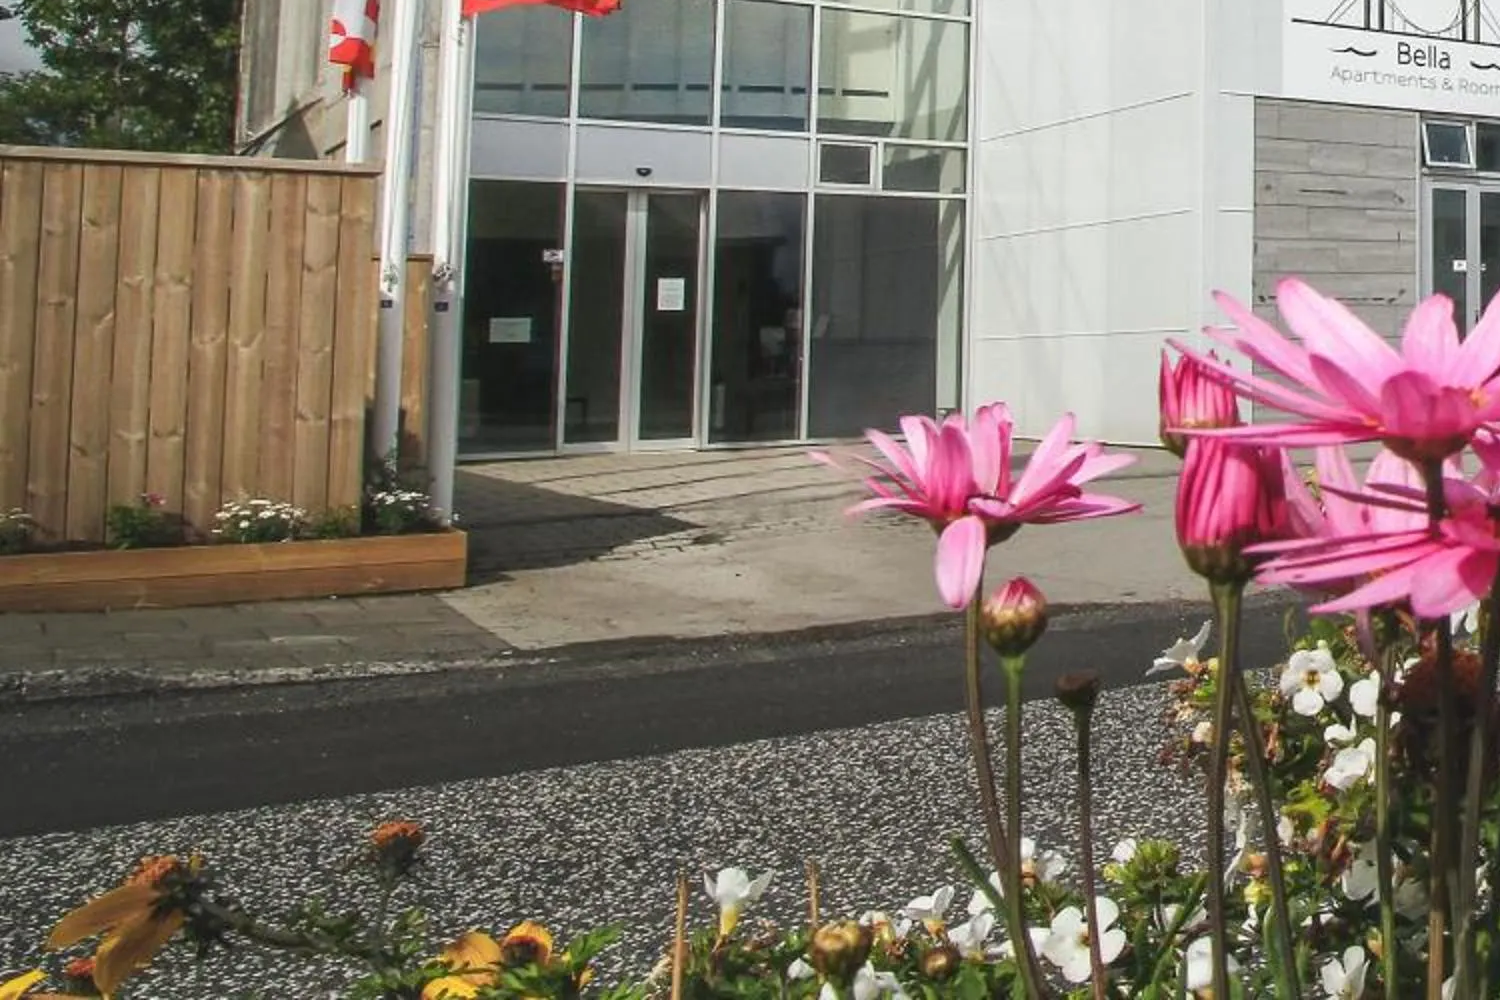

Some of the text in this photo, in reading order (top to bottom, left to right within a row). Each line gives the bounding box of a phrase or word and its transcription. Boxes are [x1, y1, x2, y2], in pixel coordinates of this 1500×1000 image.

[1397, 42, 1451, 69] Bella
[1331, 65, 1437, 90] Apartments
[1441, 77, 1453, 92] &
